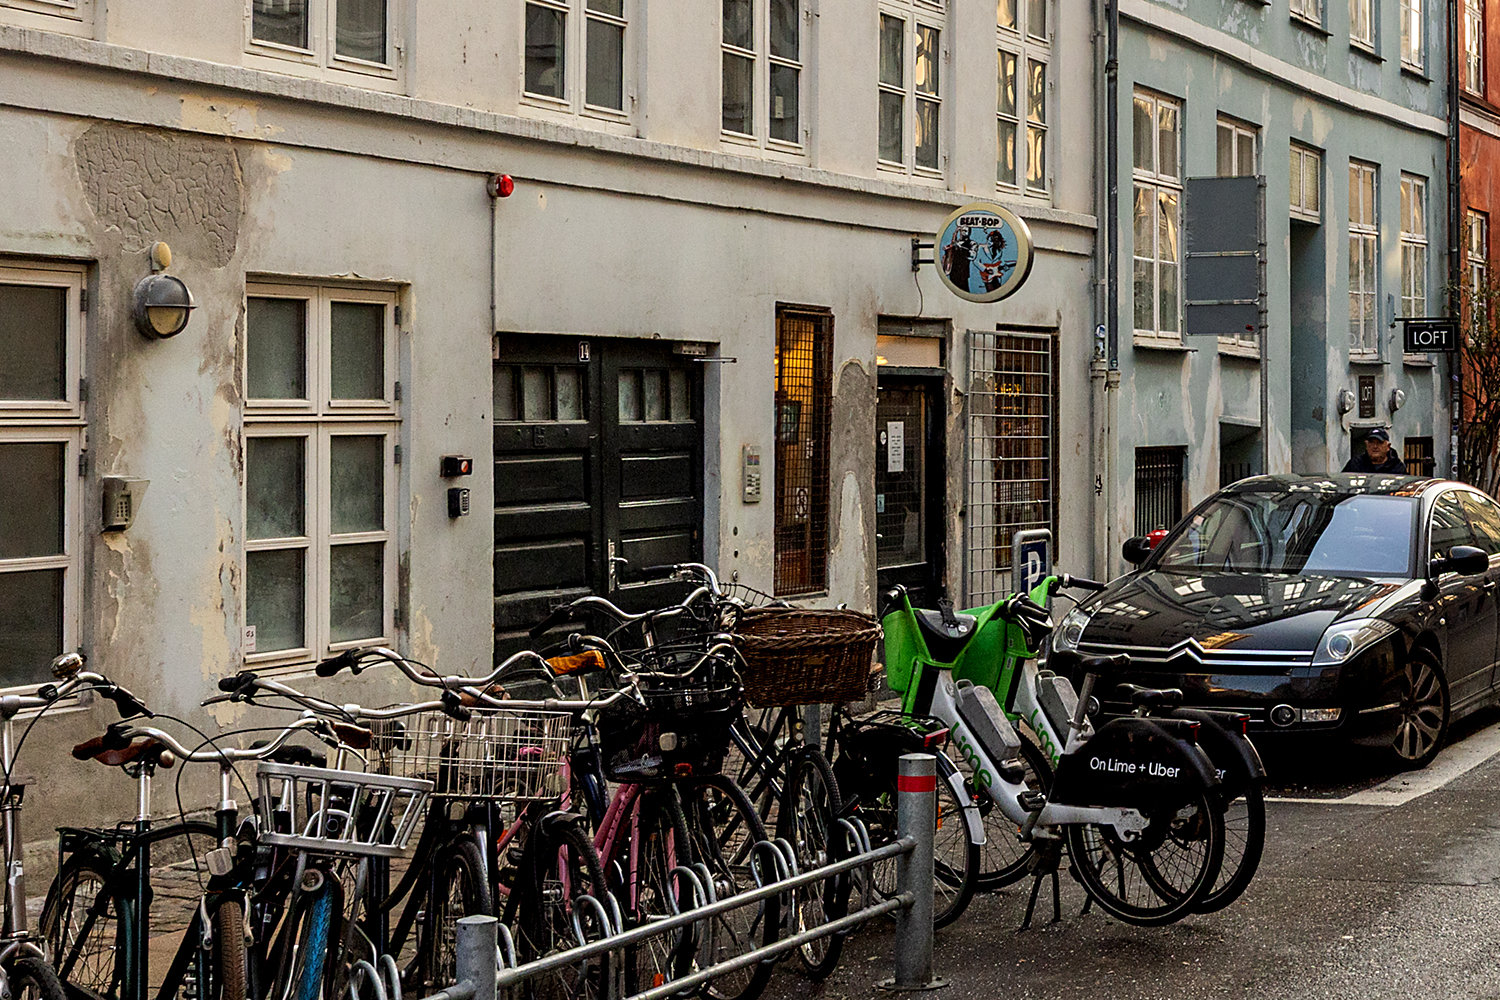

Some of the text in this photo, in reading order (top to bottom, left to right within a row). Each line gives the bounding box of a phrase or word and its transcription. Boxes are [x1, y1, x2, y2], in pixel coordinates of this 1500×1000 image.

[1413, 330, 1448, 345] LOFT
[580, 343, 589, 359] 14
[1027, 550, 1041, 597] P
[949, 721, 992, 792] Lime
[1089, 756, 1180, 778] On Lime + Uber
